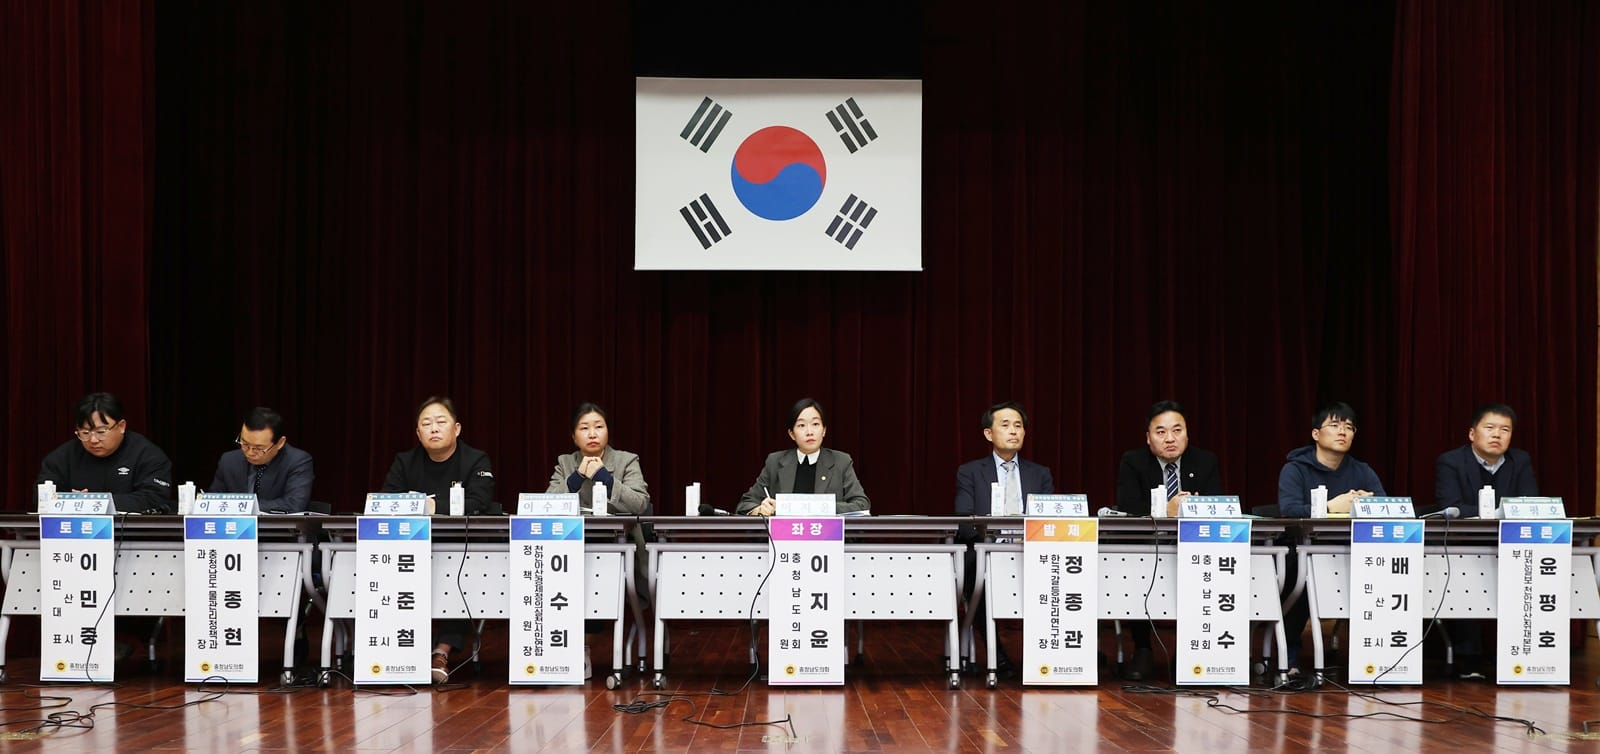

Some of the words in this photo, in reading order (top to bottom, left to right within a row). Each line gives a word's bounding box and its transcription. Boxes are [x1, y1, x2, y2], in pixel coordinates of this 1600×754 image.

[55, 501, 102, 512] 이민중
[60, 521, 93, 534] 토론
[200, 501, 247, 512] 이종현
[204, 521, 237, 534] 토론
[371, 501, 418, 512] 문준철
[377, 522, 411, 535] 토론
[524, 502, 572, 512] 이수희
[530, 522, 564, 535] 토론
[791, 522, 823, 536] 좌장
[1035, 503, 1082, 513] 정종관
[1043, 524, 1080, 537] 발제
[1188, 505, 1235, 515] 박정수
[1198, 525, 1231, 538] 토론
[1361, 505, 1409, 514] 배기호
[1372, 525, 1404, 538] 토론
[1511, 506, 1560, 516] 윤평호
[1519, 526, 1553, 539] 토론
[52, 552, 62, 644] 주민대표
[63, 552, 74, 645] 아산시
[80, 554, 97, 646] 이민중
[197, 549, 207, 650] 과장
[208, 548, 218, 589] 충청남도
[224, 554, 241, 645] 이종현
[368, 553, 379, 647] 주민대표
[380, 553, 392, 647] 아산시
[397, 555, 415, 647] 문준철
[522, 545, 533, 657] 정책위원장
[550, 555, 568, 647] 이수희
[780, 552, 789, 650] 의원
[791, 552, 802, 650] 충청남도의회
[811, 555, 828, 648] 이지윤
[1038, 554, 1049, 650] 부원장
[1050, 553, 1061, 650] 한국갈등관리연구원
[1065, 556, 1083, 648] 정종관
[1190, 554, 1200, 651] 의원
[1201, 554, 1212, 650] 충청남도의회
[1218, 557, 1236, 649] 박정수
[1363, 556, 1374, 648] 주민대표
[1374, 556, 1386, 648] 아산시
[1391, 557, 1409, 649] 배기호
[1510, 549, 1521, 656] 부장
[1524, 549, 1533, 585] 대전일보
[1538, 558, 1557, 647] 윤평호
[208, 590, 218, 650] 물관리정책과
